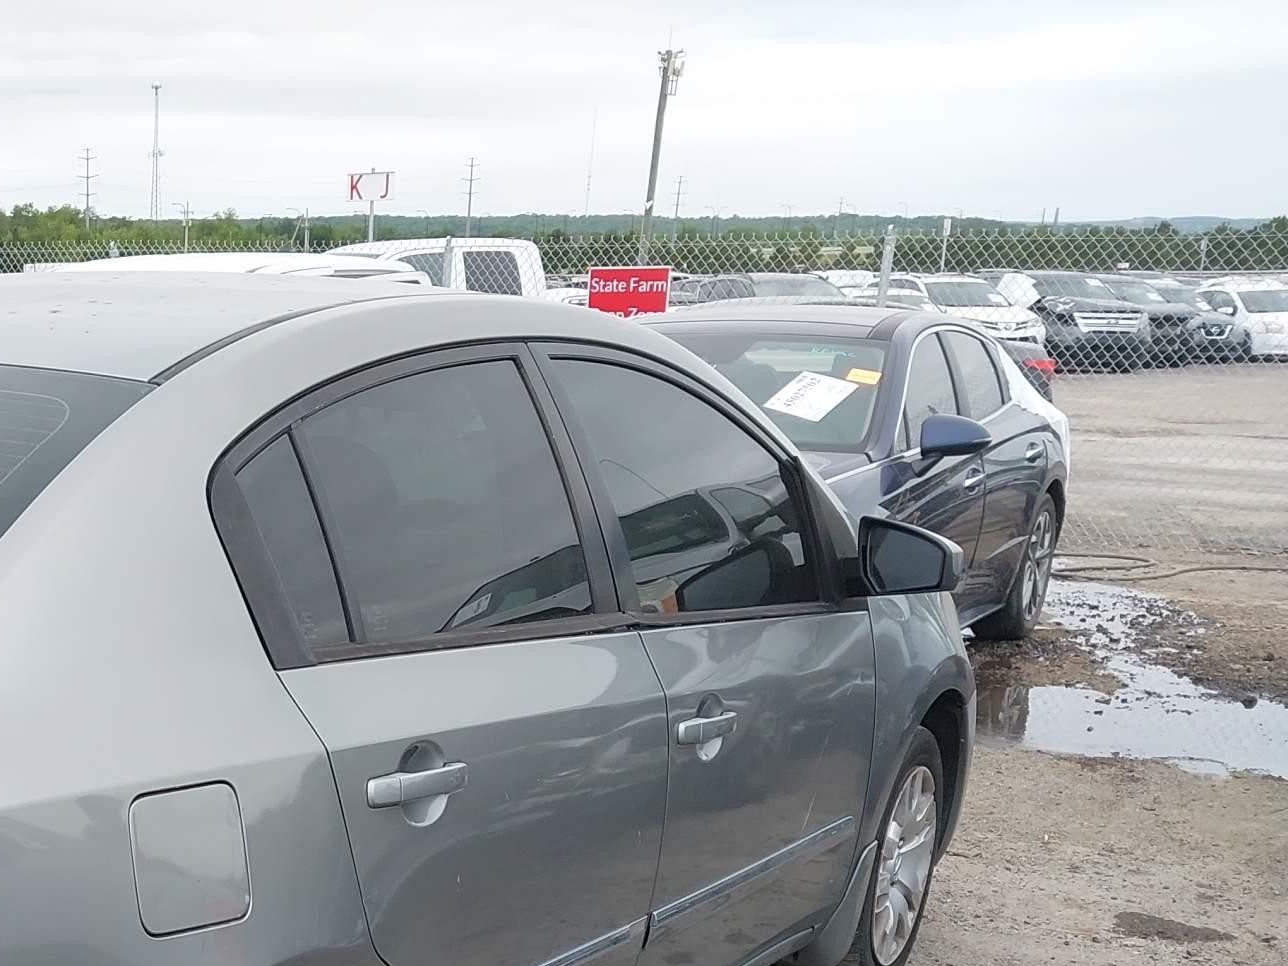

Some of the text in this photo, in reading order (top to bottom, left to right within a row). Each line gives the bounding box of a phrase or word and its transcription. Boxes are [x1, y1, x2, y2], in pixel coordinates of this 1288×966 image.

[350, 173, 390, 200] K J
[590, 277, 667, 293] State Farm
